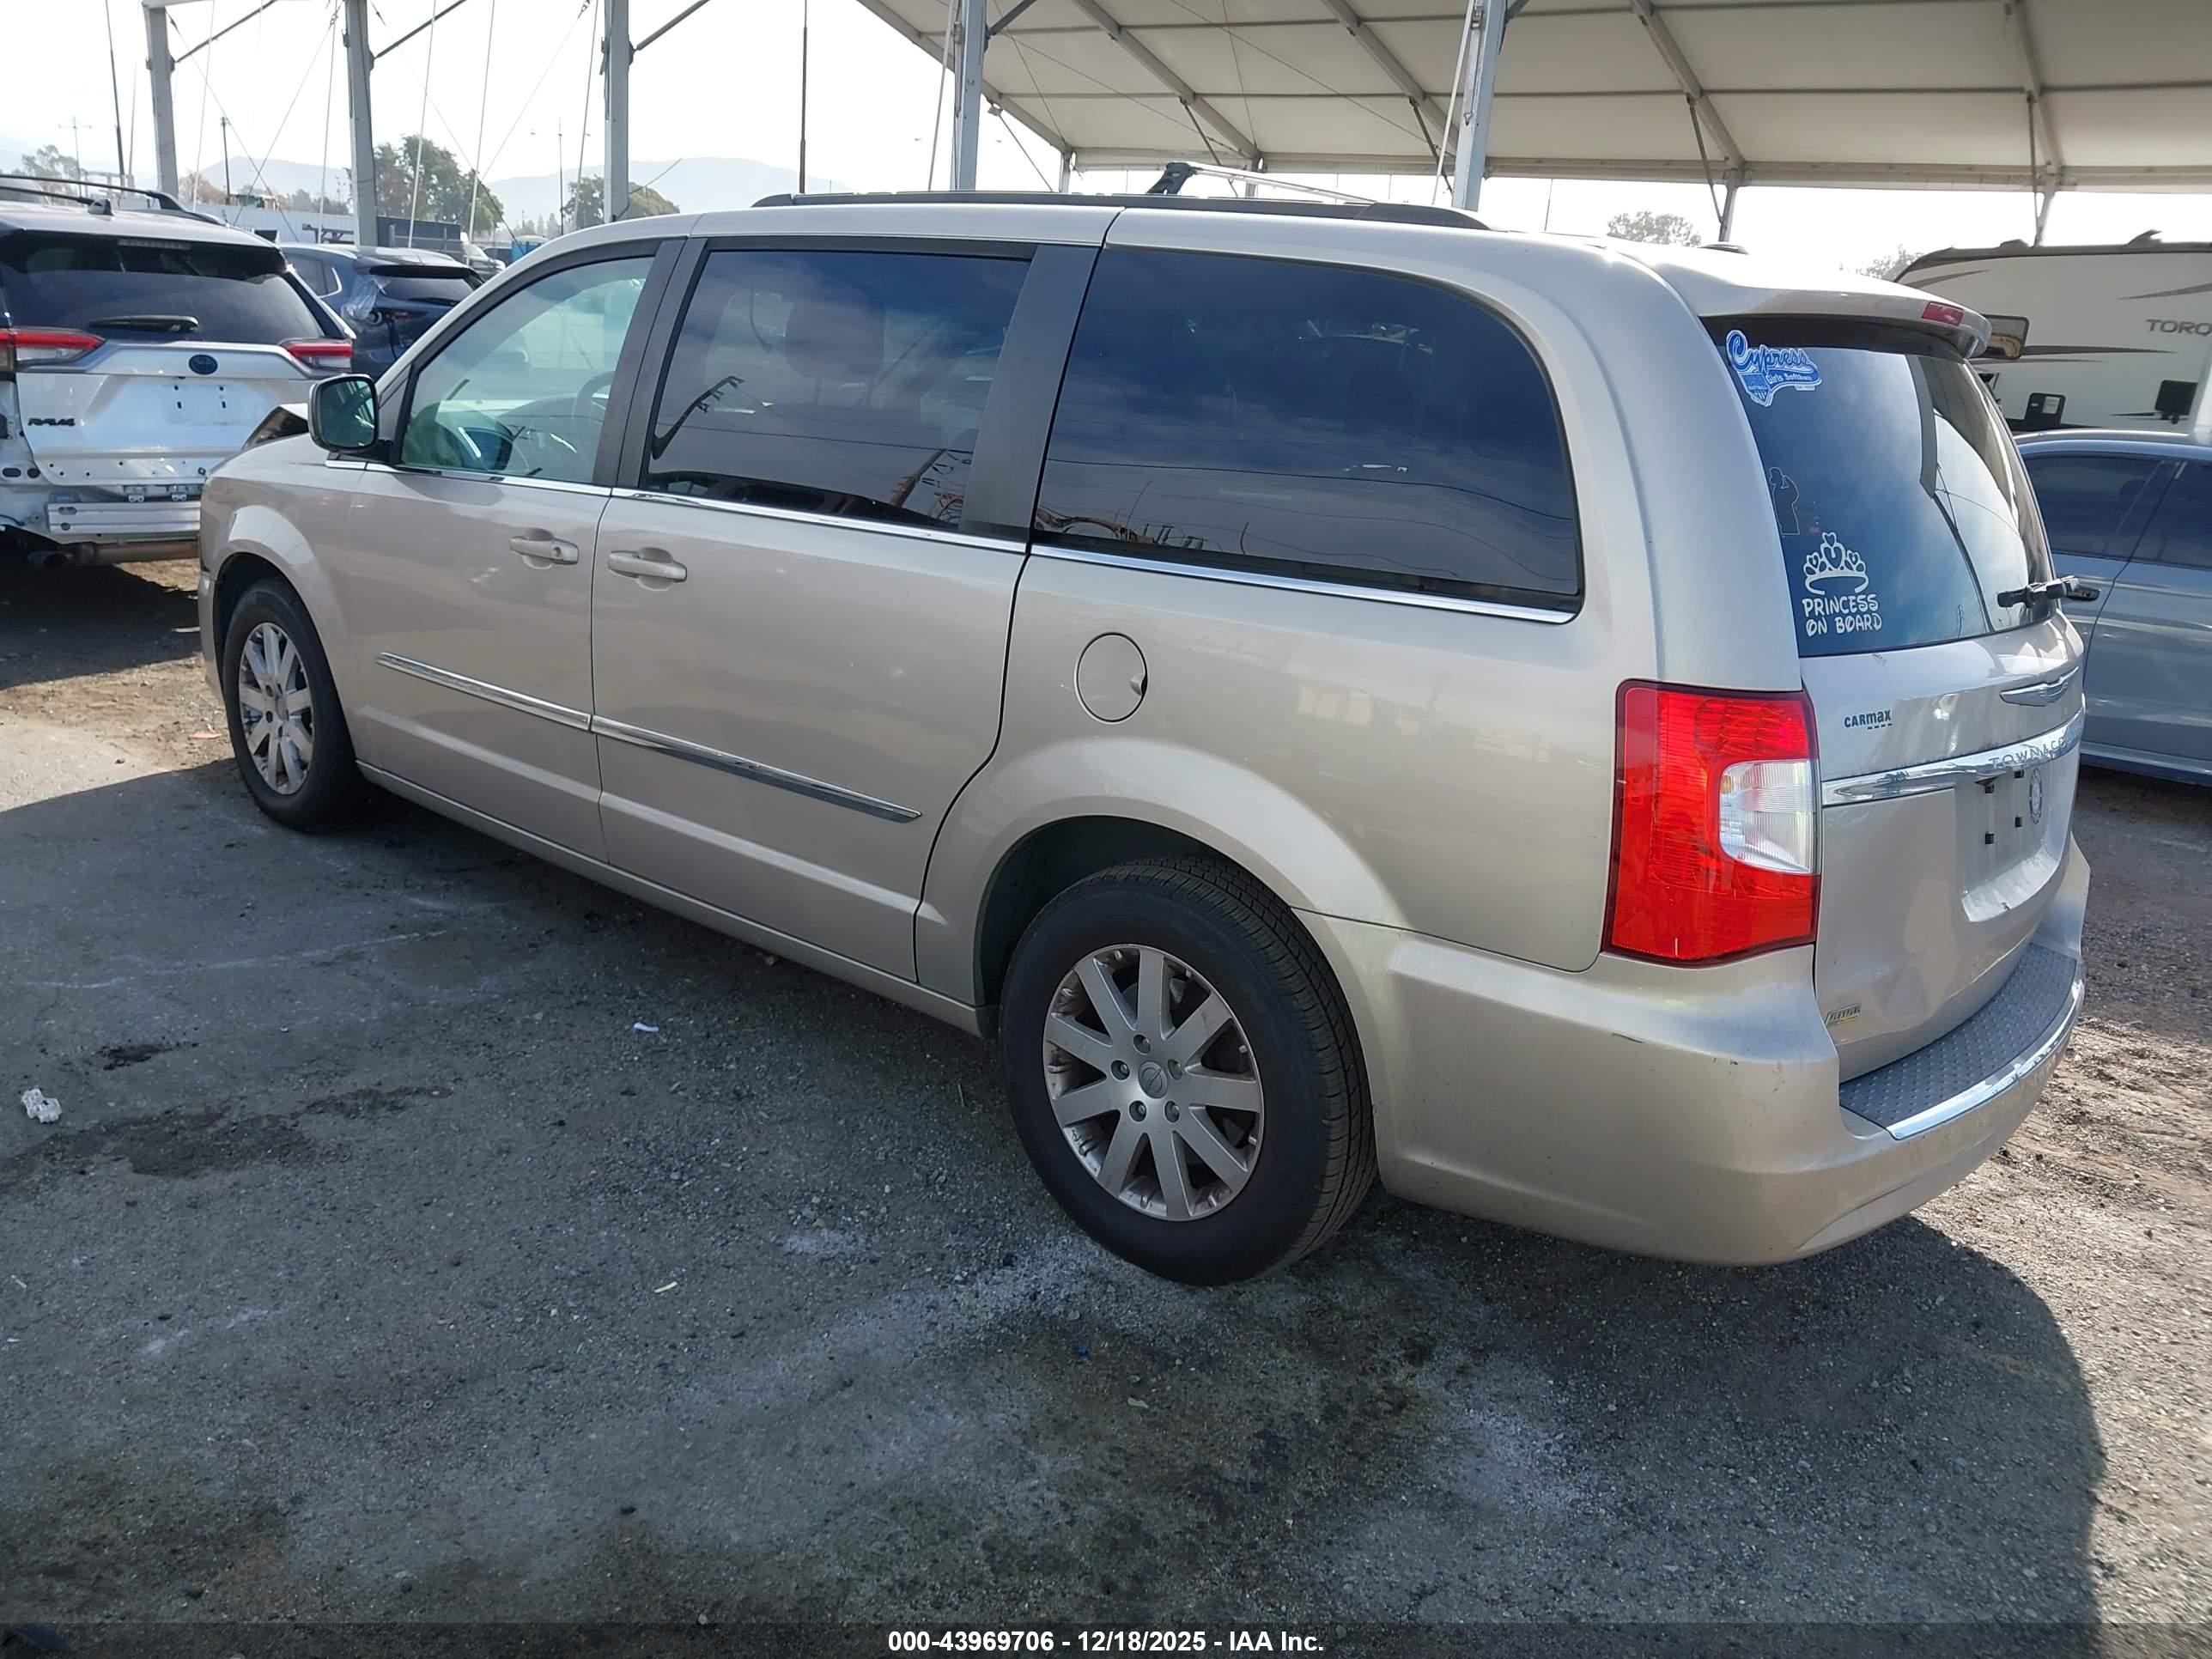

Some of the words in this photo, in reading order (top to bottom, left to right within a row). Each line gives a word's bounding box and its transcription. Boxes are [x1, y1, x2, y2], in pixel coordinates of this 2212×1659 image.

[1727, 331, 1809, 374] Cypress
[1766, 373, 1784, 385] Girls
[1802, 594, 1879, 617] PRINCESS
[1806, 617, 1827, 637] ON
[1834, 613, 1882, 634] BOARD
